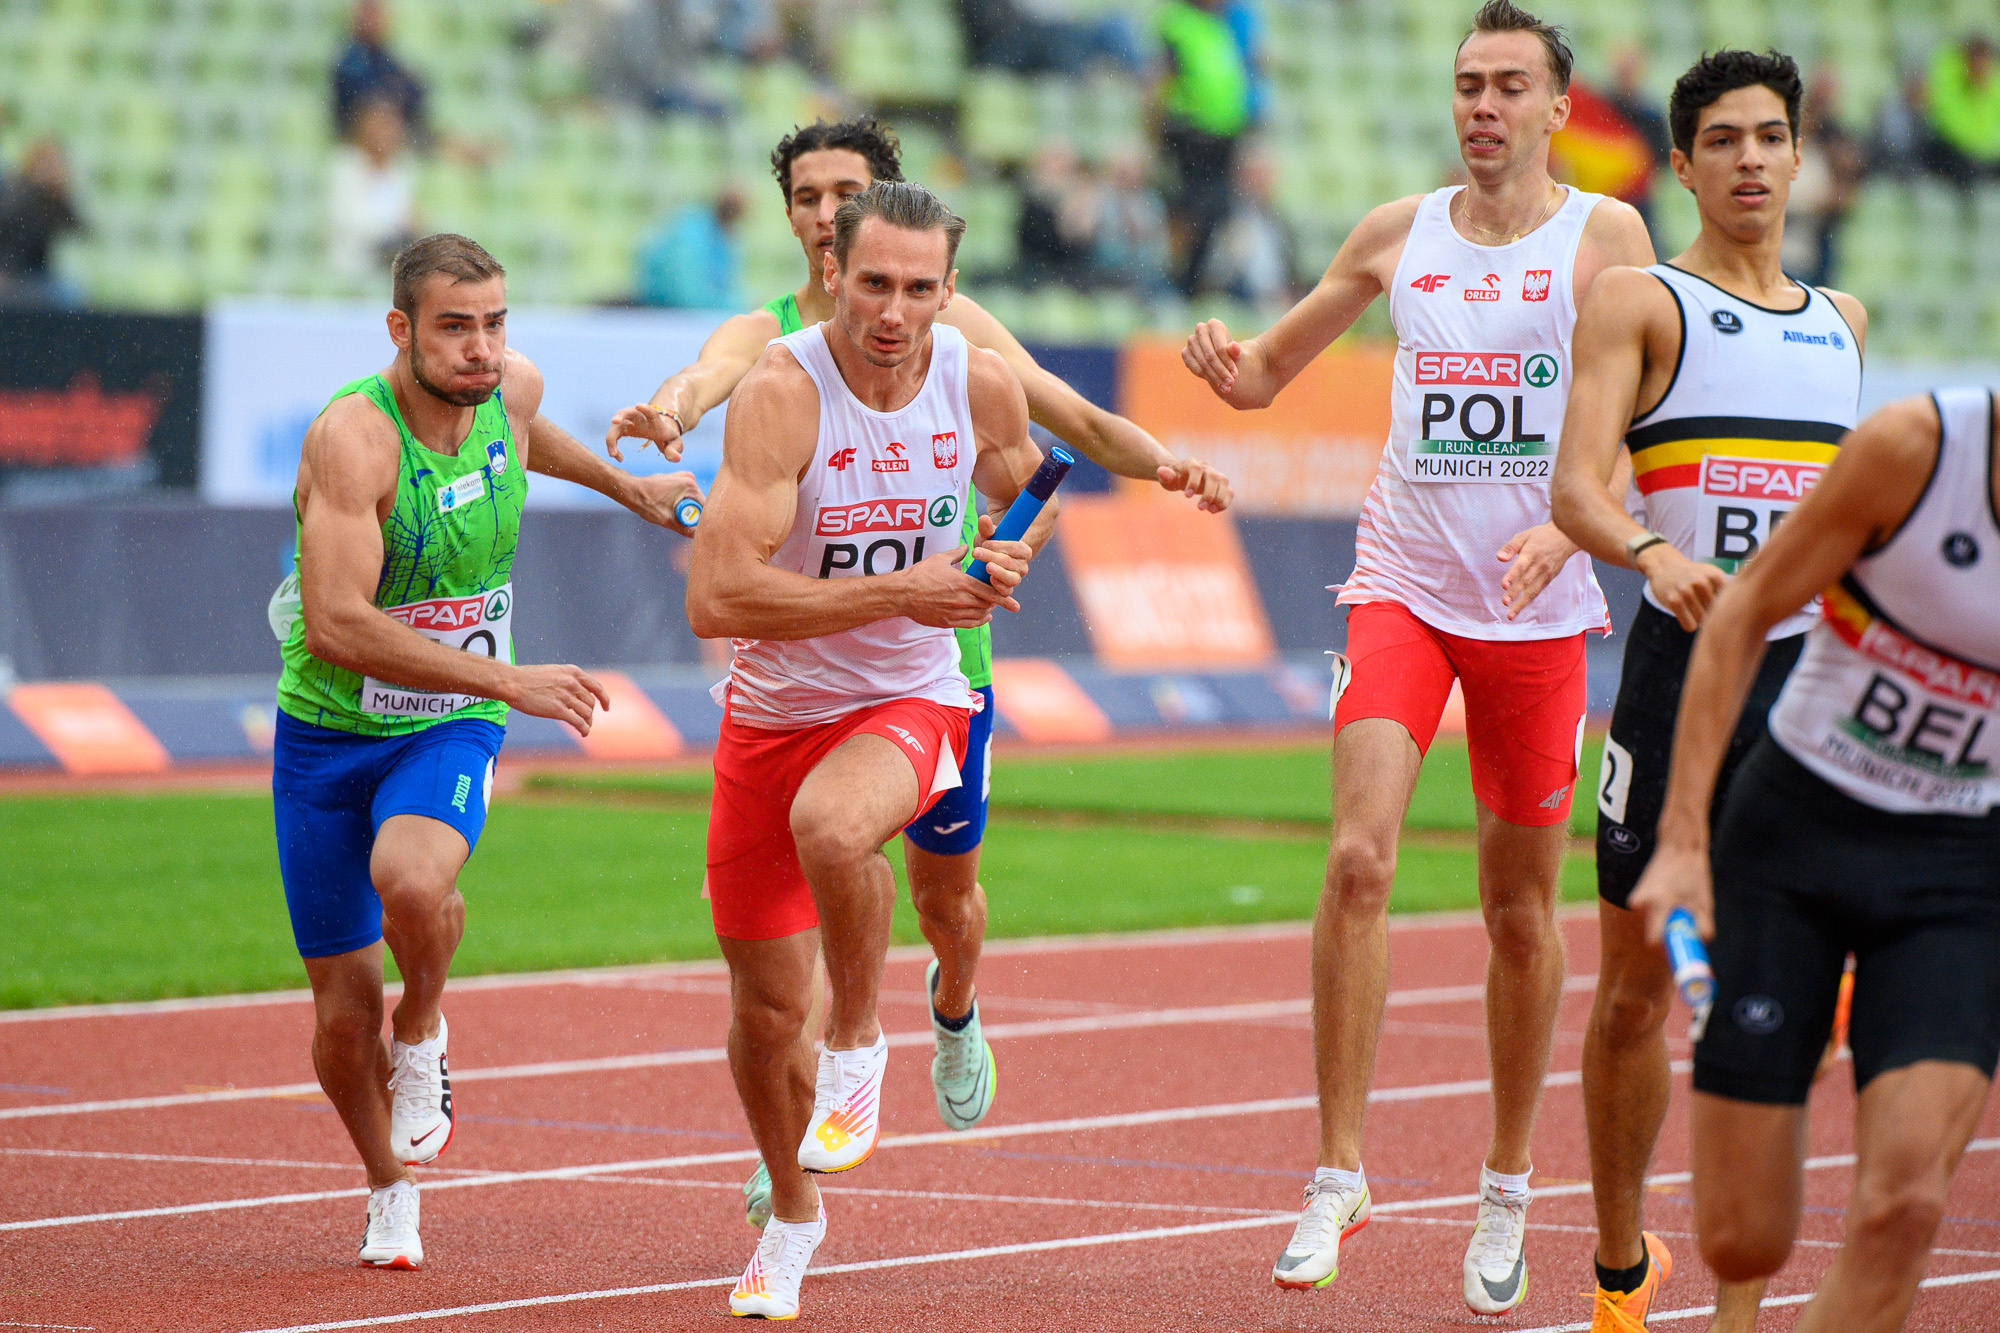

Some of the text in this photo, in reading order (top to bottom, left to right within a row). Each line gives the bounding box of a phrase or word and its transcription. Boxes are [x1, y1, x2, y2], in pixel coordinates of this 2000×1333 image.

[1410, 274, 1451, 293] 4F
[1464, 291, 1499, 301] ORLEN
[1783, 330, 1829, 345] Allianz
[1418, 356, 1518, 382] SPAR
[1421, 393, 1546, 442] POL
[1445, 442, 1474, 454] RUN
[828, 448, 857, 471] 4F
[872, 461, 908, 472] ORLEN
[1415, 458, 1549, 478] MUNICH 2022
[820, 503, 923, 533] SPAR
[373, 691, 454, 713] MUNICH
[1854, 671, 1988, 768] BEL
[1602, 750, 1617, 806] 2
